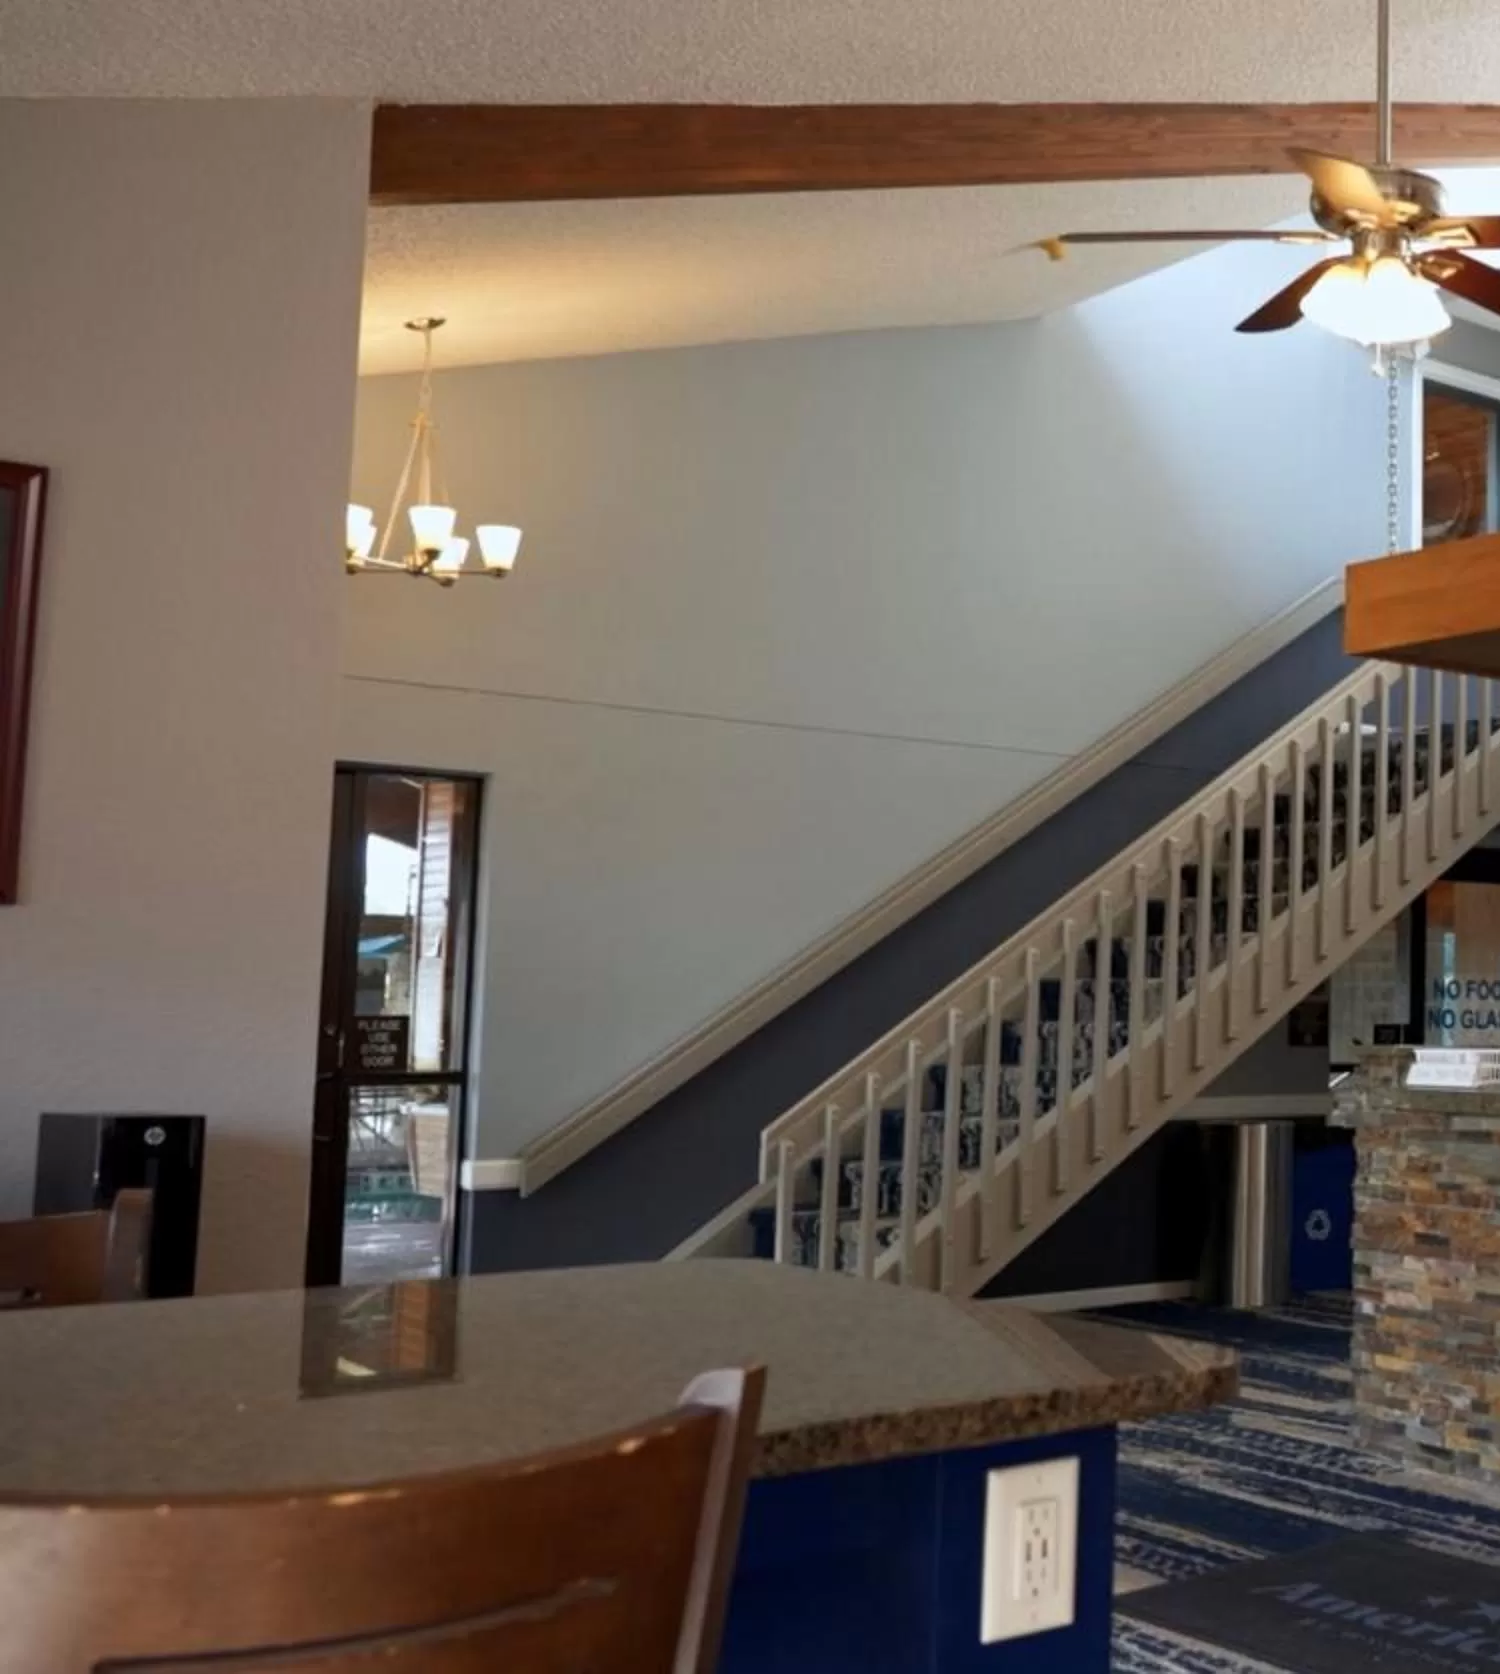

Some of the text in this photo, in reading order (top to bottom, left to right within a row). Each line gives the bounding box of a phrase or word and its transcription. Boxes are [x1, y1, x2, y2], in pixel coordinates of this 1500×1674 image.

[1433, 979, 1460, 1001] NO
[1428, 1008, 1456, 1030] NO
[358, 1020, 400, 1032] PLEASE
[367, 1032, 391, 1043] USE
[360, 1043, 397, 1055] OTHER
[361, 1055, 395, 1067] DOOR
